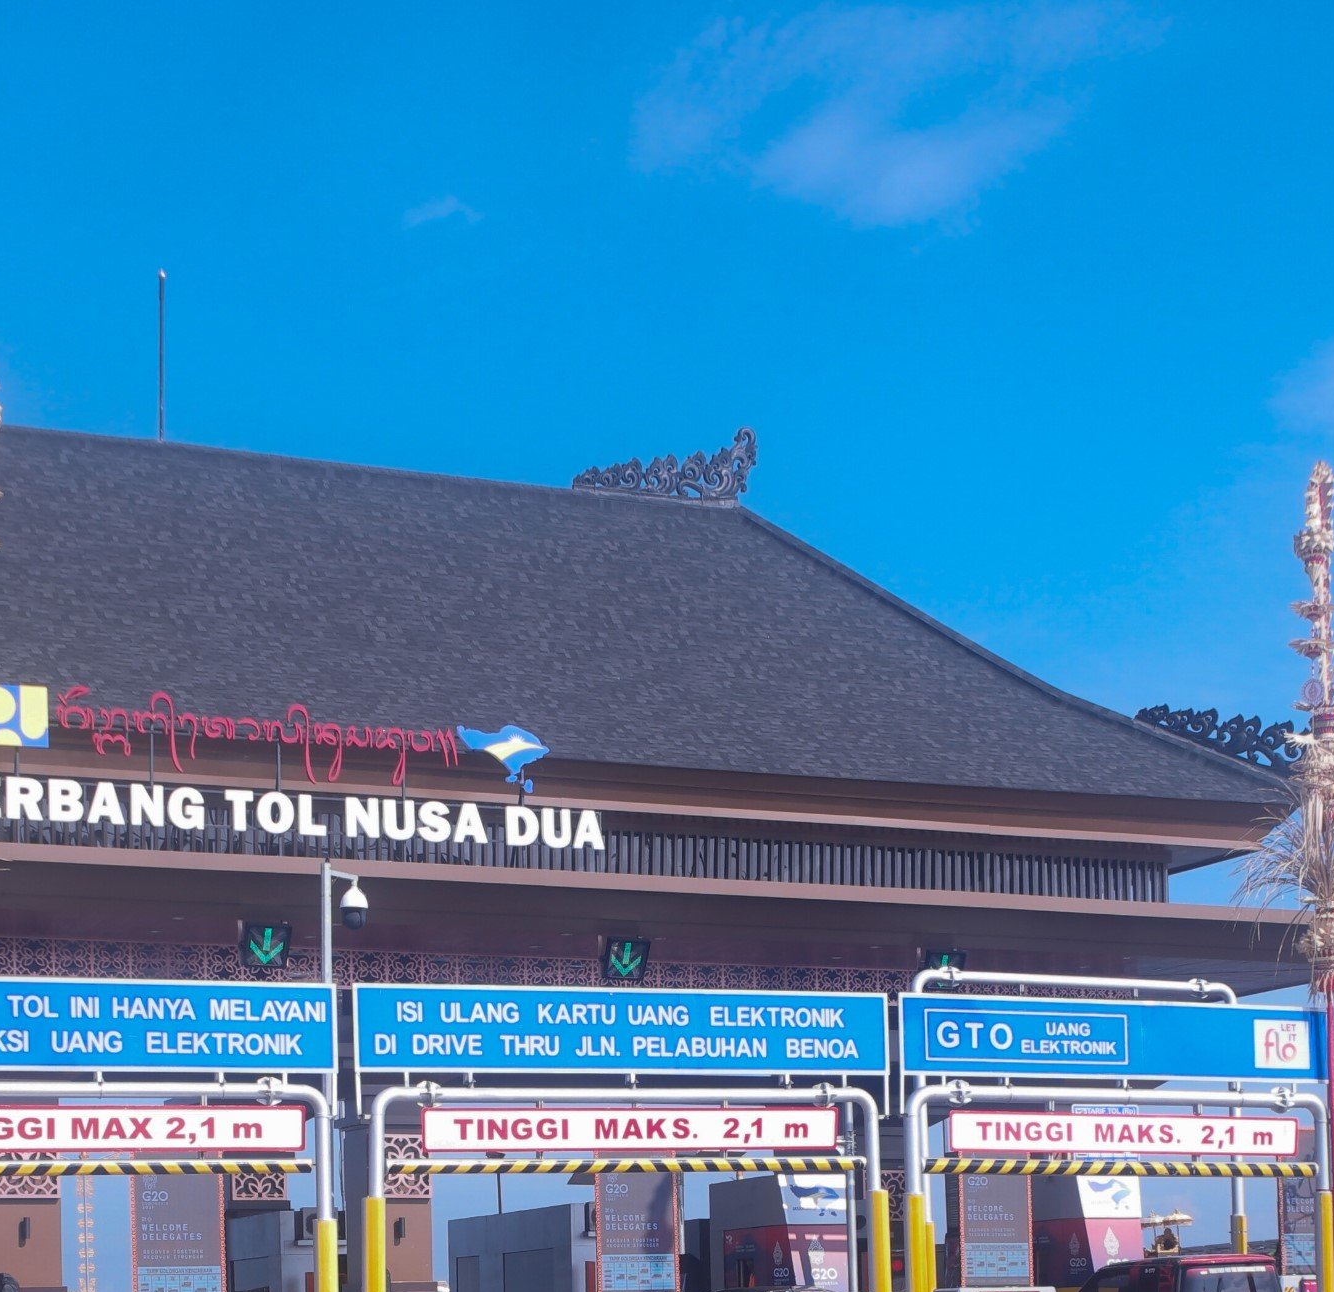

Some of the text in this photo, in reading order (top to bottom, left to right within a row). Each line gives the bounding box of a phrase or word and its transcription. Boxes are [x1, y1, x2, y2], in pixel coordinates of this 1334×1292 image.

[224, 789, 327, 836] TOL
[344, 796, 489, 845] NUSA
[504, 805, 606, 850] DUA
[7, 994, 59, 1018] TOL
[70, 996, 100, 1019] INI
[112, 997, 196, 1020] HANYA
[209, 999, 326, 1023] MELAYANI
[396, 1001, 845, 1029] ISI ULANG KARTU UANG ELEKTRONIK
[936, 1021, 1014, 1050] GTO
[1045, 1022, 1091, 1036] UANG
[51, 1031, 123, 1054] UANG
[146, 1032, 303, 1056] ELEKTRONIK
[374, 1033, 859, 1059] DI DRIVE THRU JLN. PELABUHAN BENOA
[1020, 1039, 1117, 1055] ELEKTRONIK
[1264, 1028, 1297, 1064] flo
[70, 1117, 153, 1140] MAX
[166, 1117, 216, 1145] 2,1
[232, 1122, 263, 1139] m
[454, 1118, 809, 1144] TINGGI MAKS. 2,1 m
[976, 1121, 1273, 1149] TINGGI MAKS. 2,1 m
[605, 1184, 628, 1194] G20
[968, 1176, 988, 1186] G20
[142, 1191, 168, 1201] G20
[968, 1213, 1014, 1221] DELEGATES
[774, 1268, 789, 1277] G20
[812, 1268, 838, 1279] G20
[1070, 1258, 1086, 1267] G20
